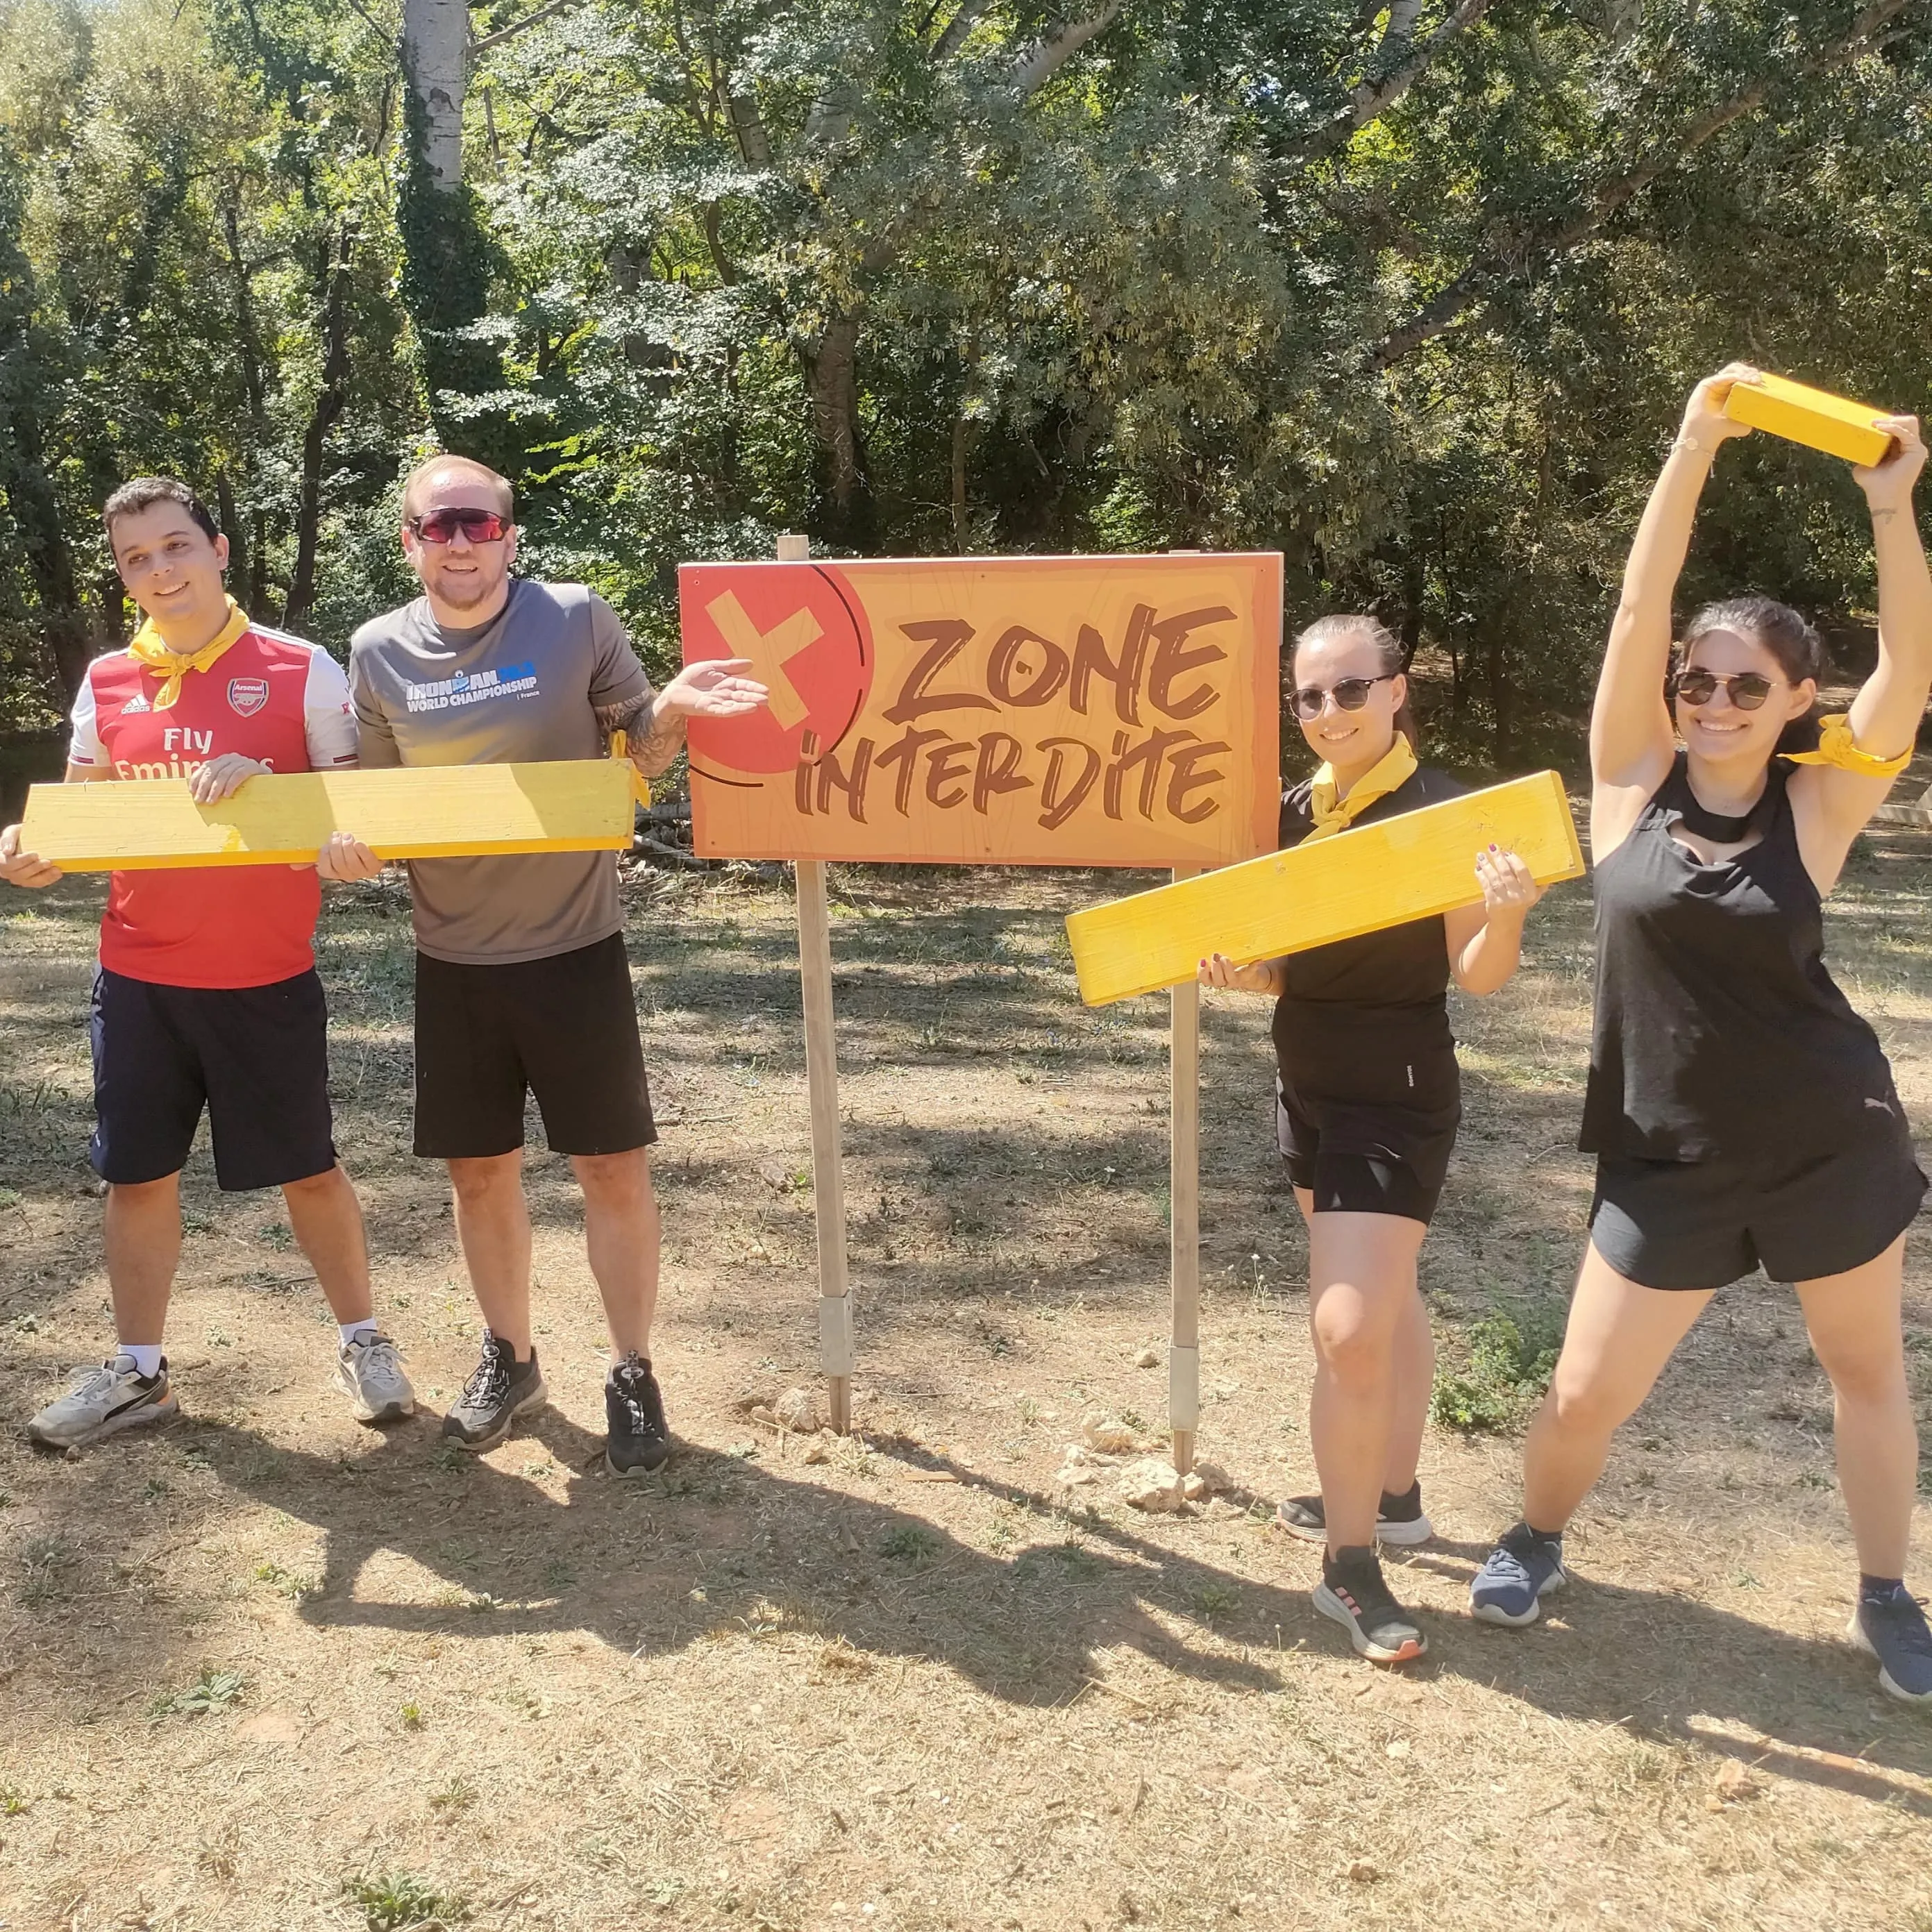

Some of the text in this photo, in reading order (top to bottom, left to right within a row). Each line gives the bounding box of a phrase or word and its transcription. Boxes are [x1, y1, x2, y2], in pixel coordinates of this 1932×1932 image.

[882, 603, 1238, 728] ZONE
[407, 676, 537, 712] WORLD CHAMPIONSHIP
[121, 705, 151, 714] adidas
[164, 727, 213, 755] Fly
[115, 753, 274, 780] Emirs
